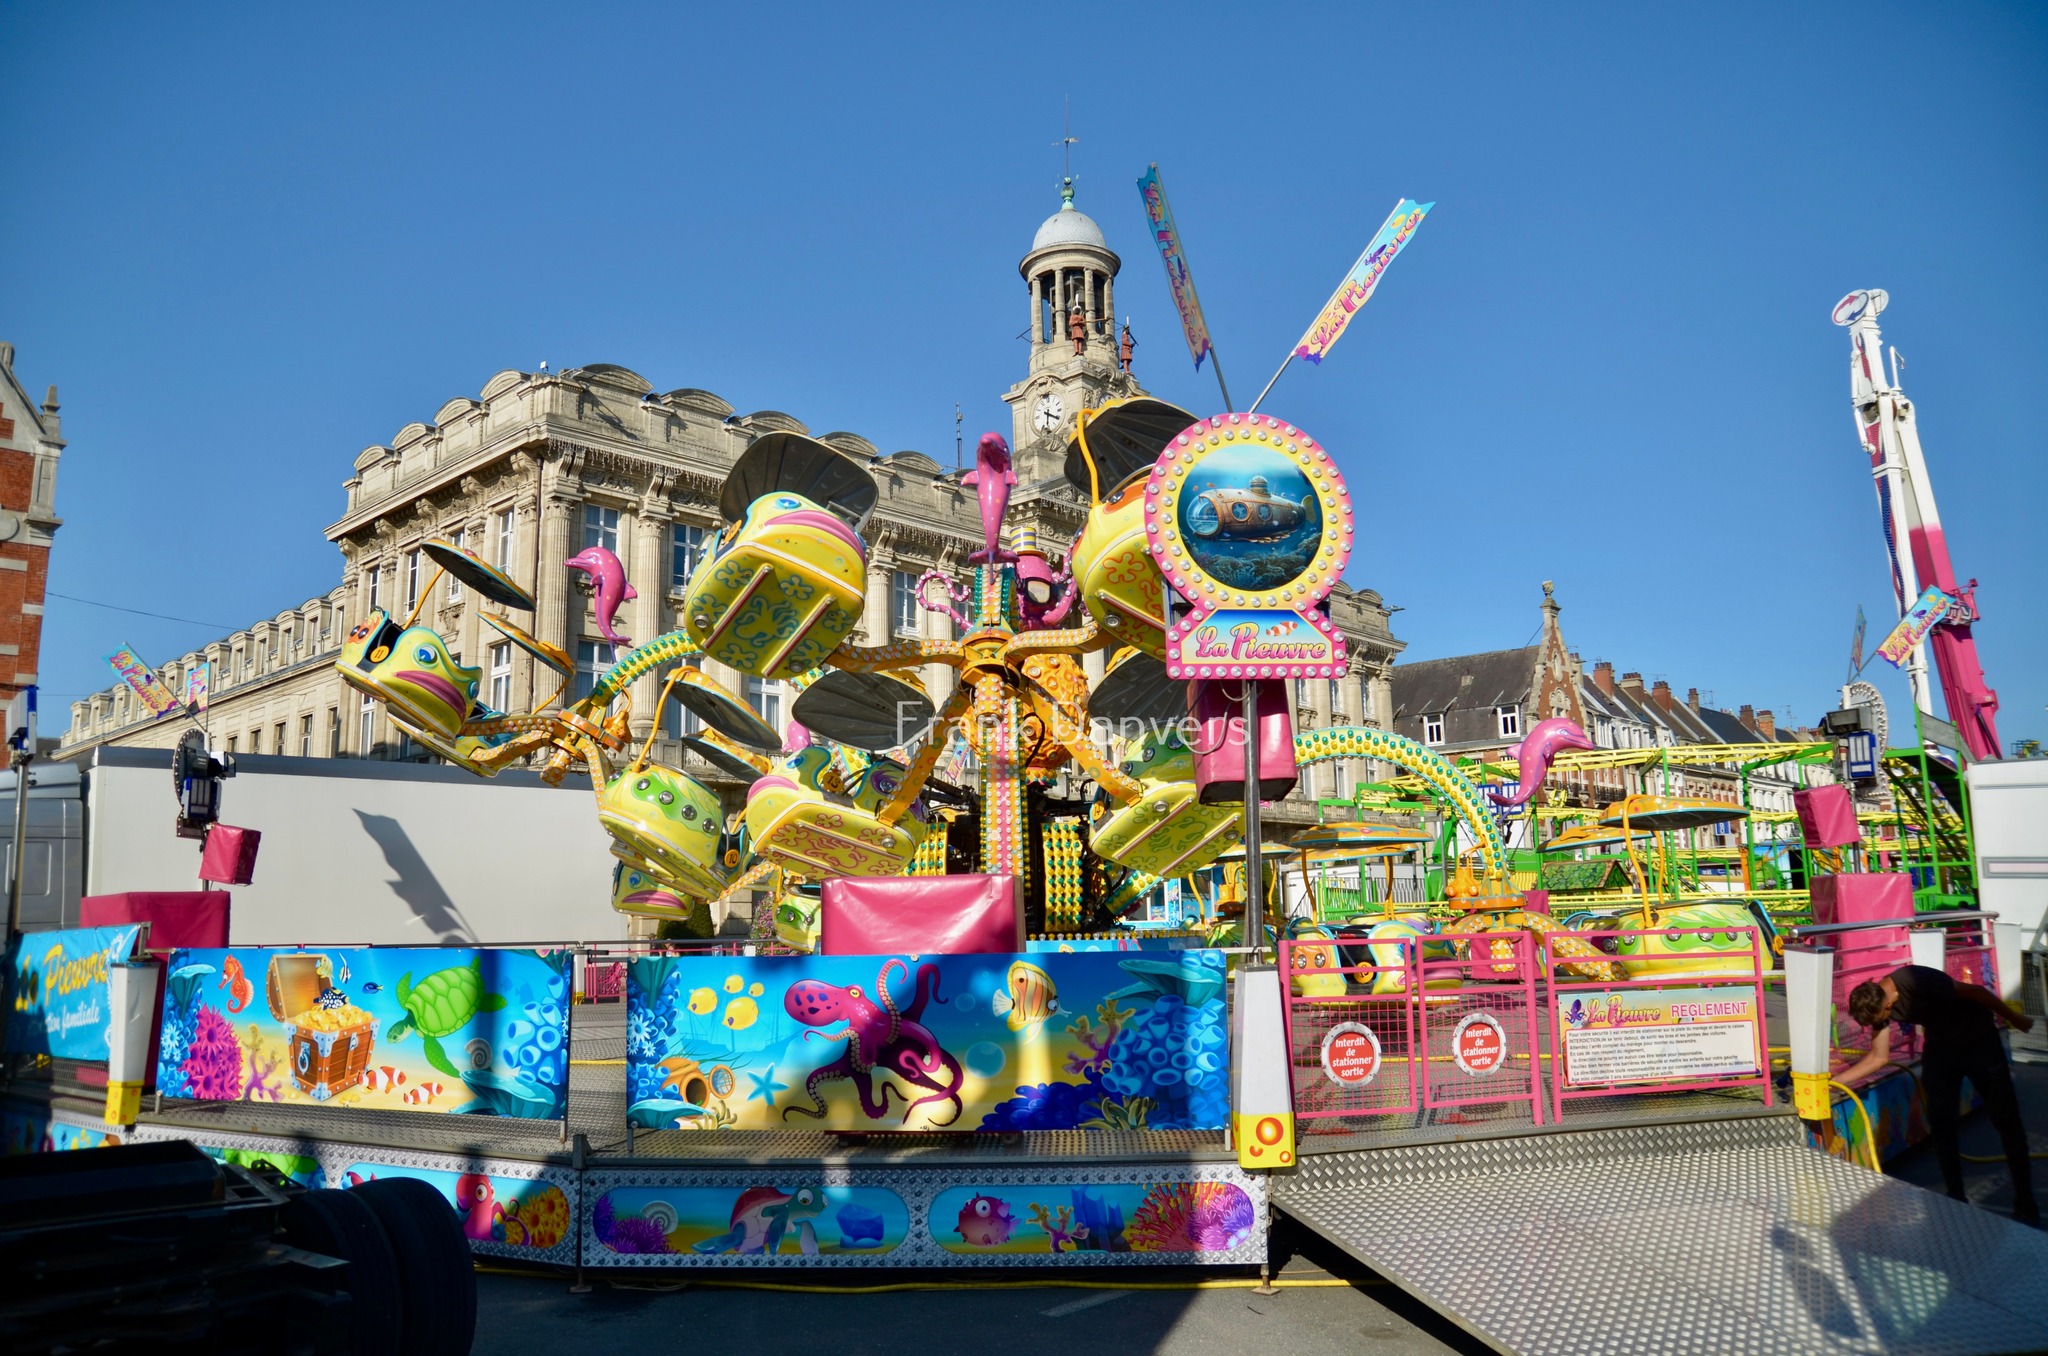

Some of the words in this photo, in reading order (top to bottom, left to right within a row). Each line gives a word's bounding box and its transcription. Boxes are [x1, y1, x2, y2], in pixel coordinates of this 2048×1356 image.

[1310, 313, 1346, 348] La
[1333, 212, 1420, 313] Pieuvre
[1195, 625, 1229, 658] La
[1230, 621, 1327, 661] Pieuvre
[43, 943, 110, 1008] Pieuvre
[1587, 998, 1606, 1024] La
[1606, 993, 1661, 1025] Pieuvre
[1670, 1001, 1748, 1018] REGLEMENT
[1465, 1027, 1492, 1038] Interdit
[1335, 1036, 1365, 1048] Interdit
[1475, 1037, 1484, 1047] de
[1346, 1047, 1356, 1057] de
[1463, 1045, 1499, 1057] stationner
[1332, 1056, 1373, 1067] stationner
[1471, 1056, 1492, 1067] sortie
[1341, 1066, 1364, 1077] sortie
